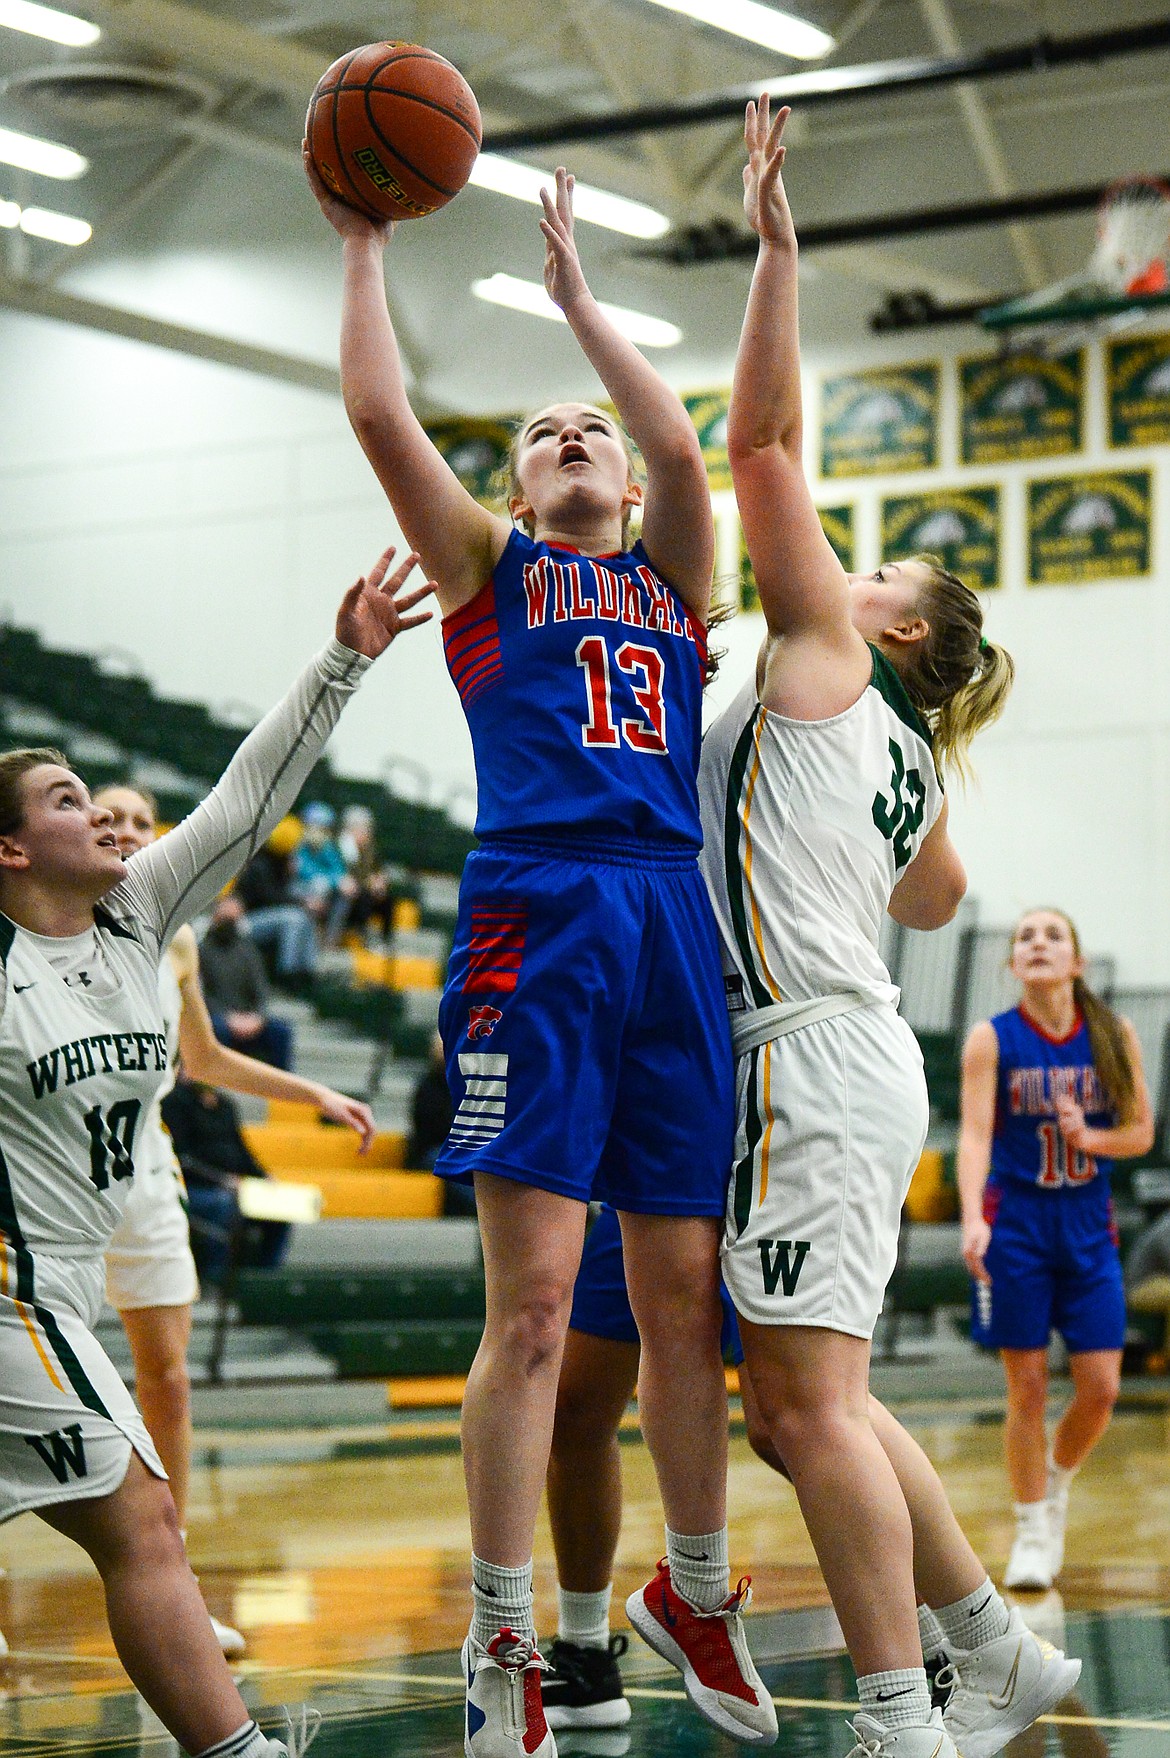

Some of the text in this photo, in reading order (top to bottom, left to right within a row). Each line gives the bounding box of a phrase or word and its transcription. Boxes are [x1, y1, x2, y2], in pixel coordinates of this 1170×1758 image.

[575, 635, 669, 756] 13
[872, 736, 926, 871] 32
[84, 1098, 142, 1190] 10
[757, 1239, 811, 1297] W
[24, 1422, 88, 1484] W
